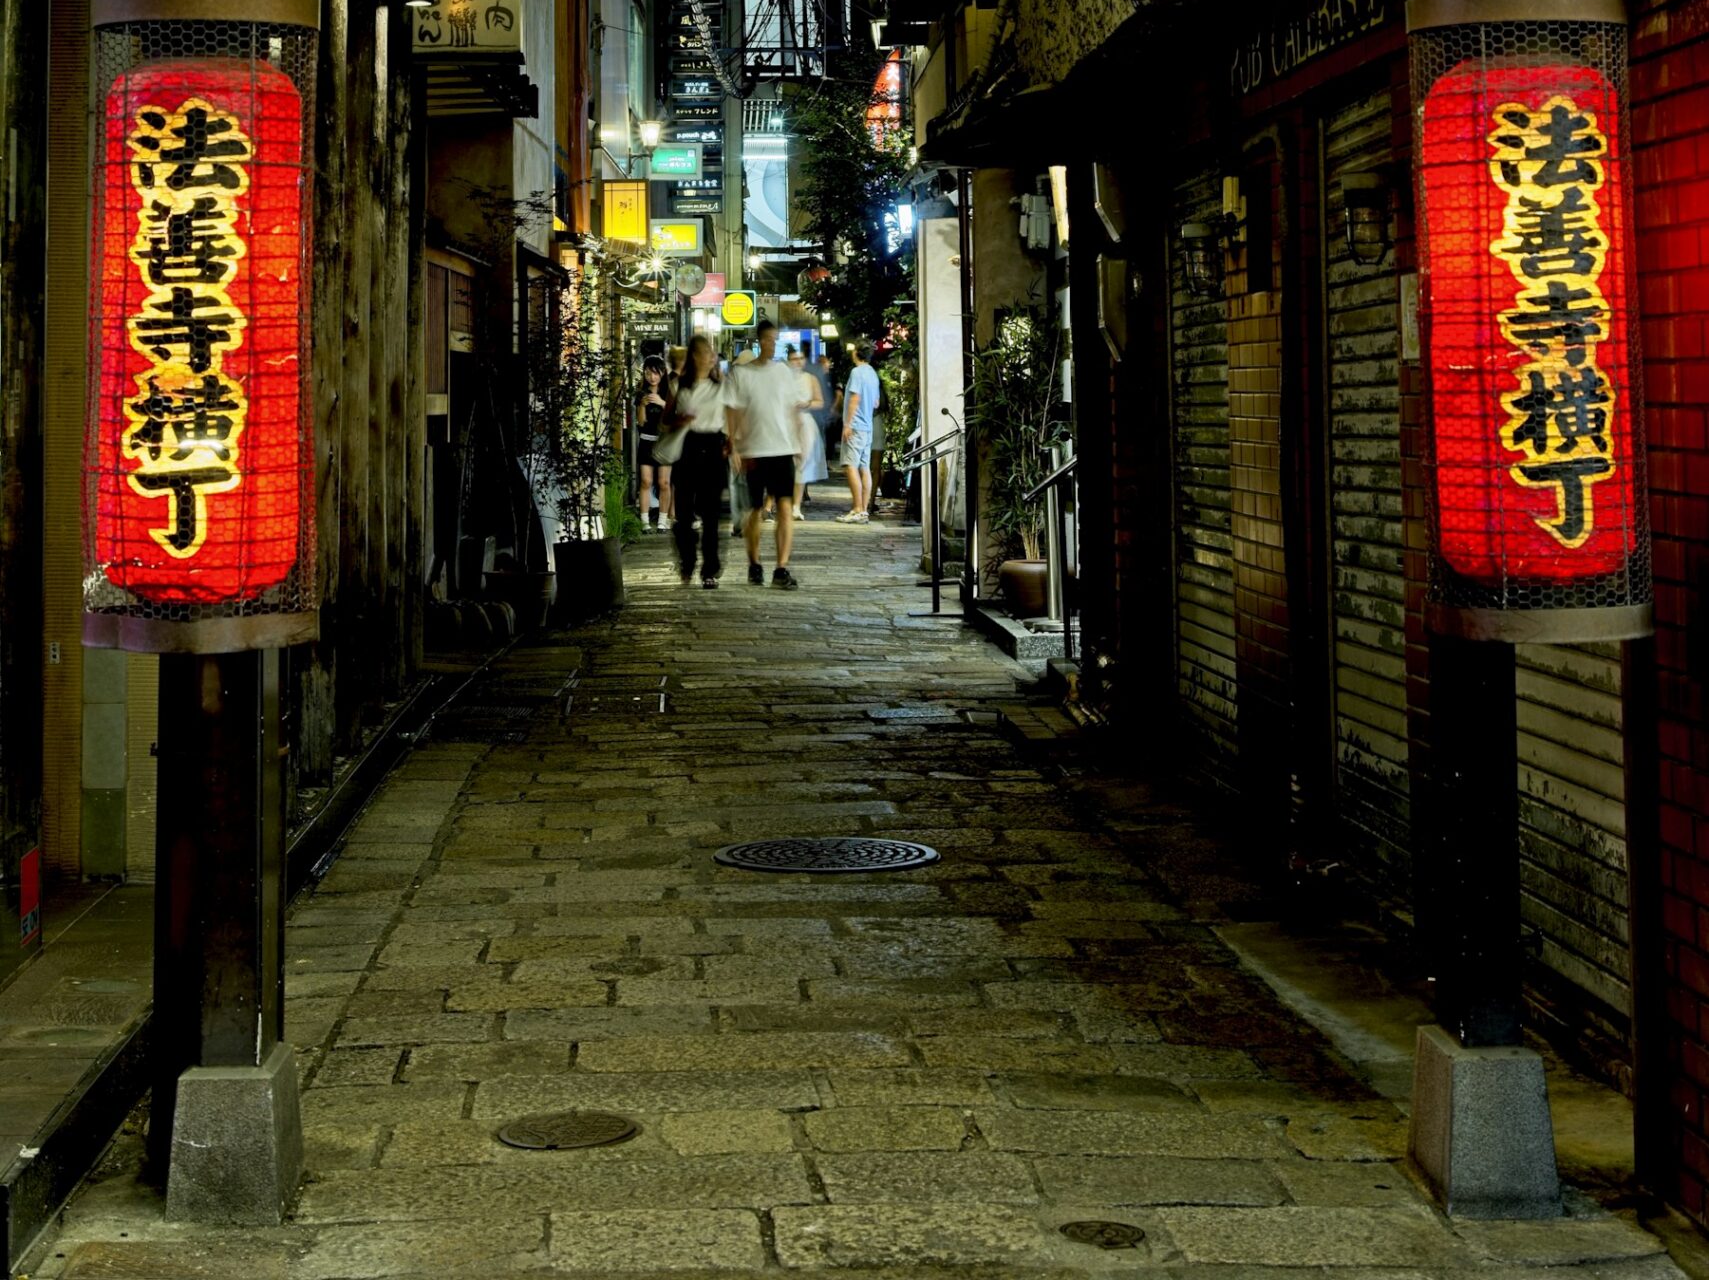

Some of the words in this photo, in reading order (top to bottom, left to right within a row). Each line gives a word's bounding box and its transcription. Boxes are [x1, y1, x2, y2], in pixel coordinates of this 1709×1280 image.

[128, 102, 251, 555] 法善寺横丁
[633, 324, 652, 332] WINE
[653, 324, 668, 332] BAR
[1493, 100, 1613, 544] 法善寺横丁
